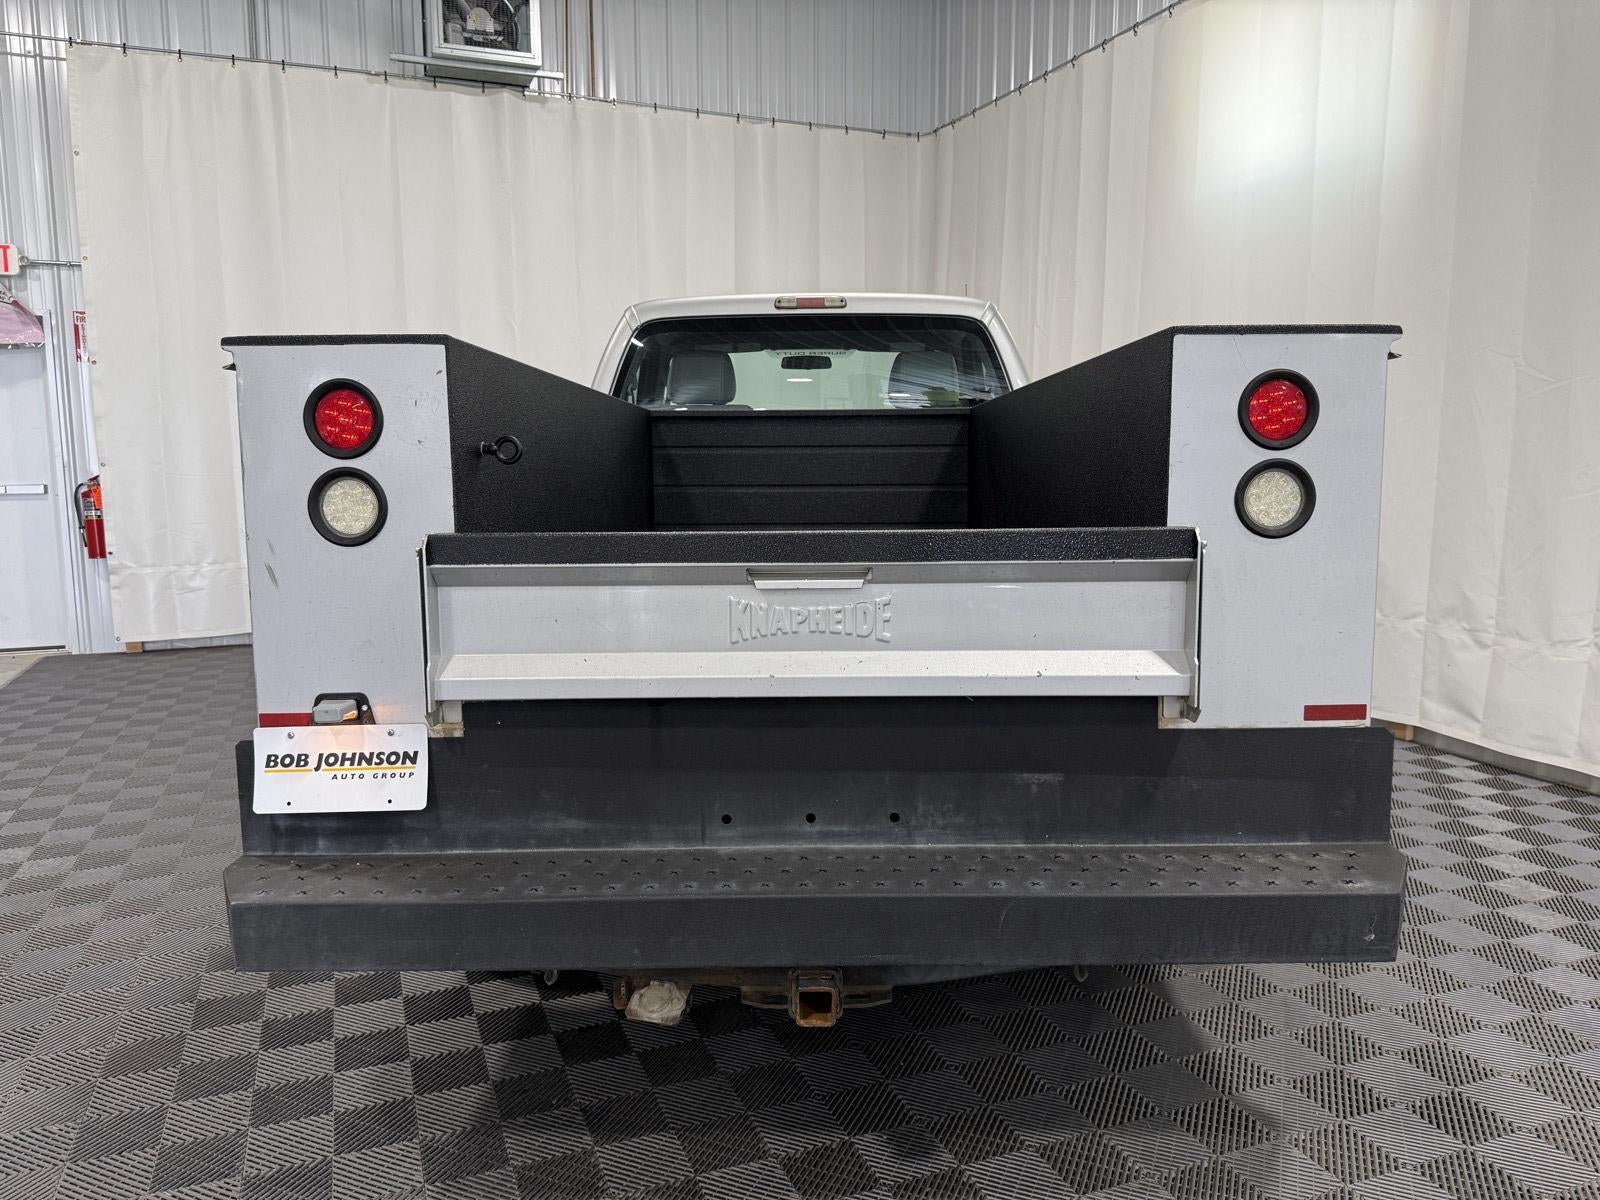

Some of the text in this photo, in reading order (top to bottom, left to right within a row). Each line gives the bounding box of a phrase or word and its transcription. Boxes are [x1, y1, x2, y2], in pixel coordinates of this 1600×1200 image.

[728, 596, 892, 645] KNAPHEIDE
[265, 750, 419, 772] BOB JOHNSON
[331, 772, 415, 781] AUTO GROUP
